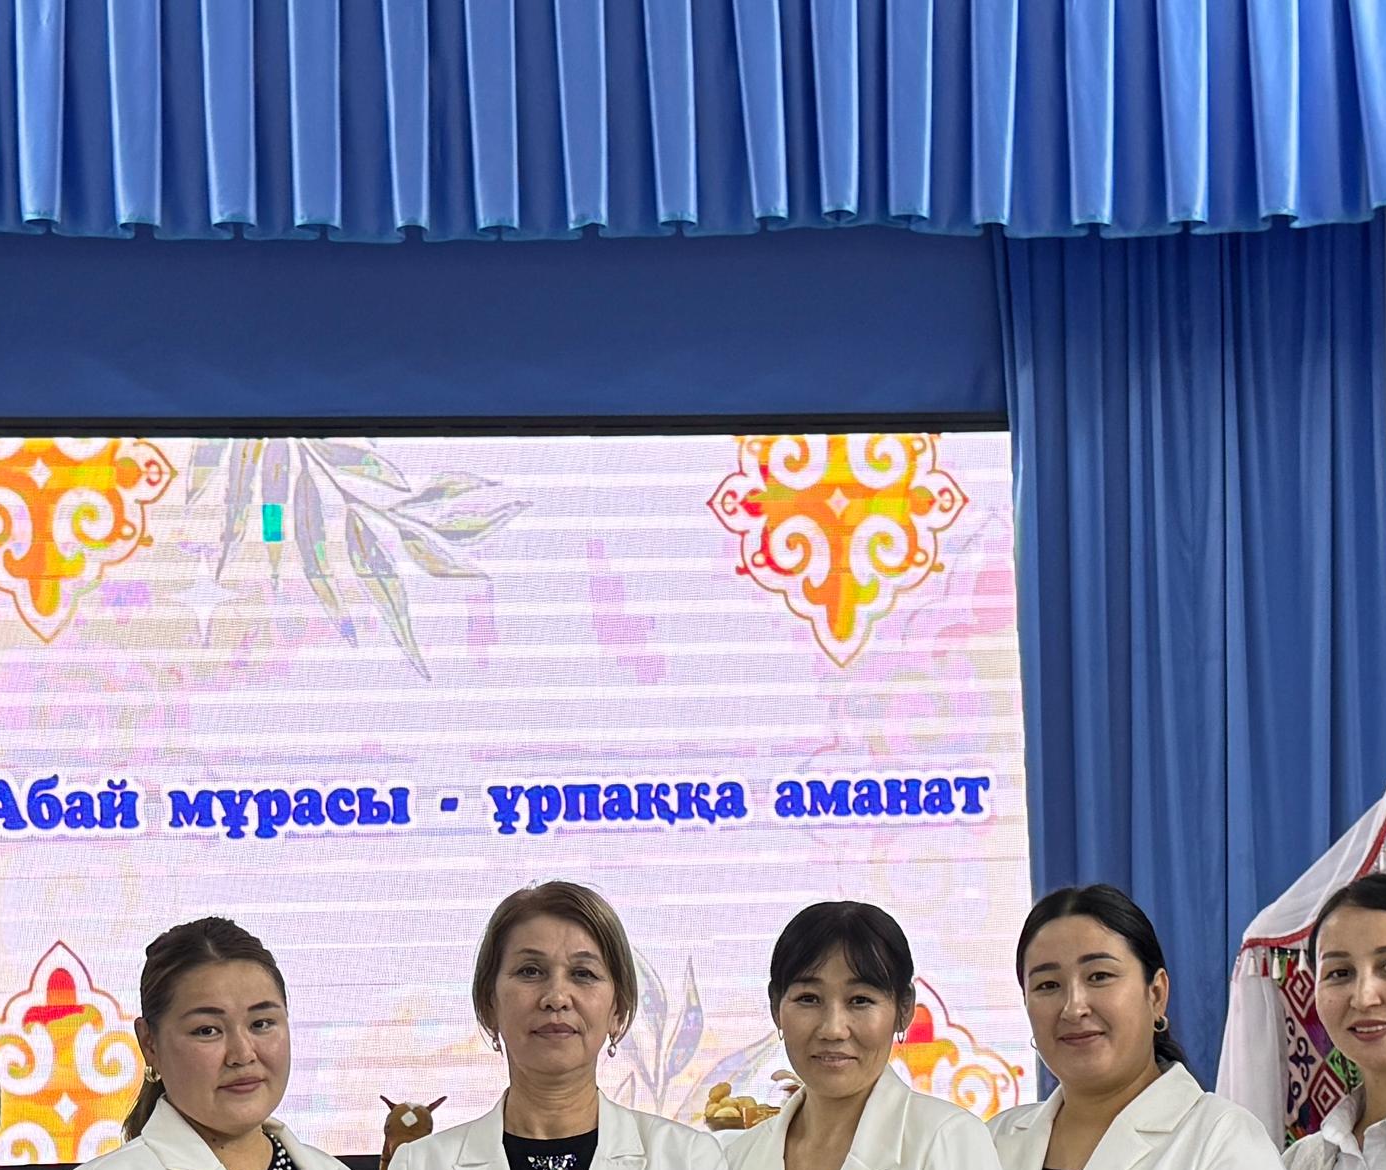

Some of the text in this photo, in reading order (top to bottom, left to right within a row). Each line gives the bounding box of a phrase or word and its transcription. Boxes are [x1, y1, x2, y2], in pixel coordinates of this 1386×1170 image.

[168, 786, 411, 839] мұрасы
[486, 780, 748, 836] ұрпаққа
[774, 776, 991, 819] аманат
